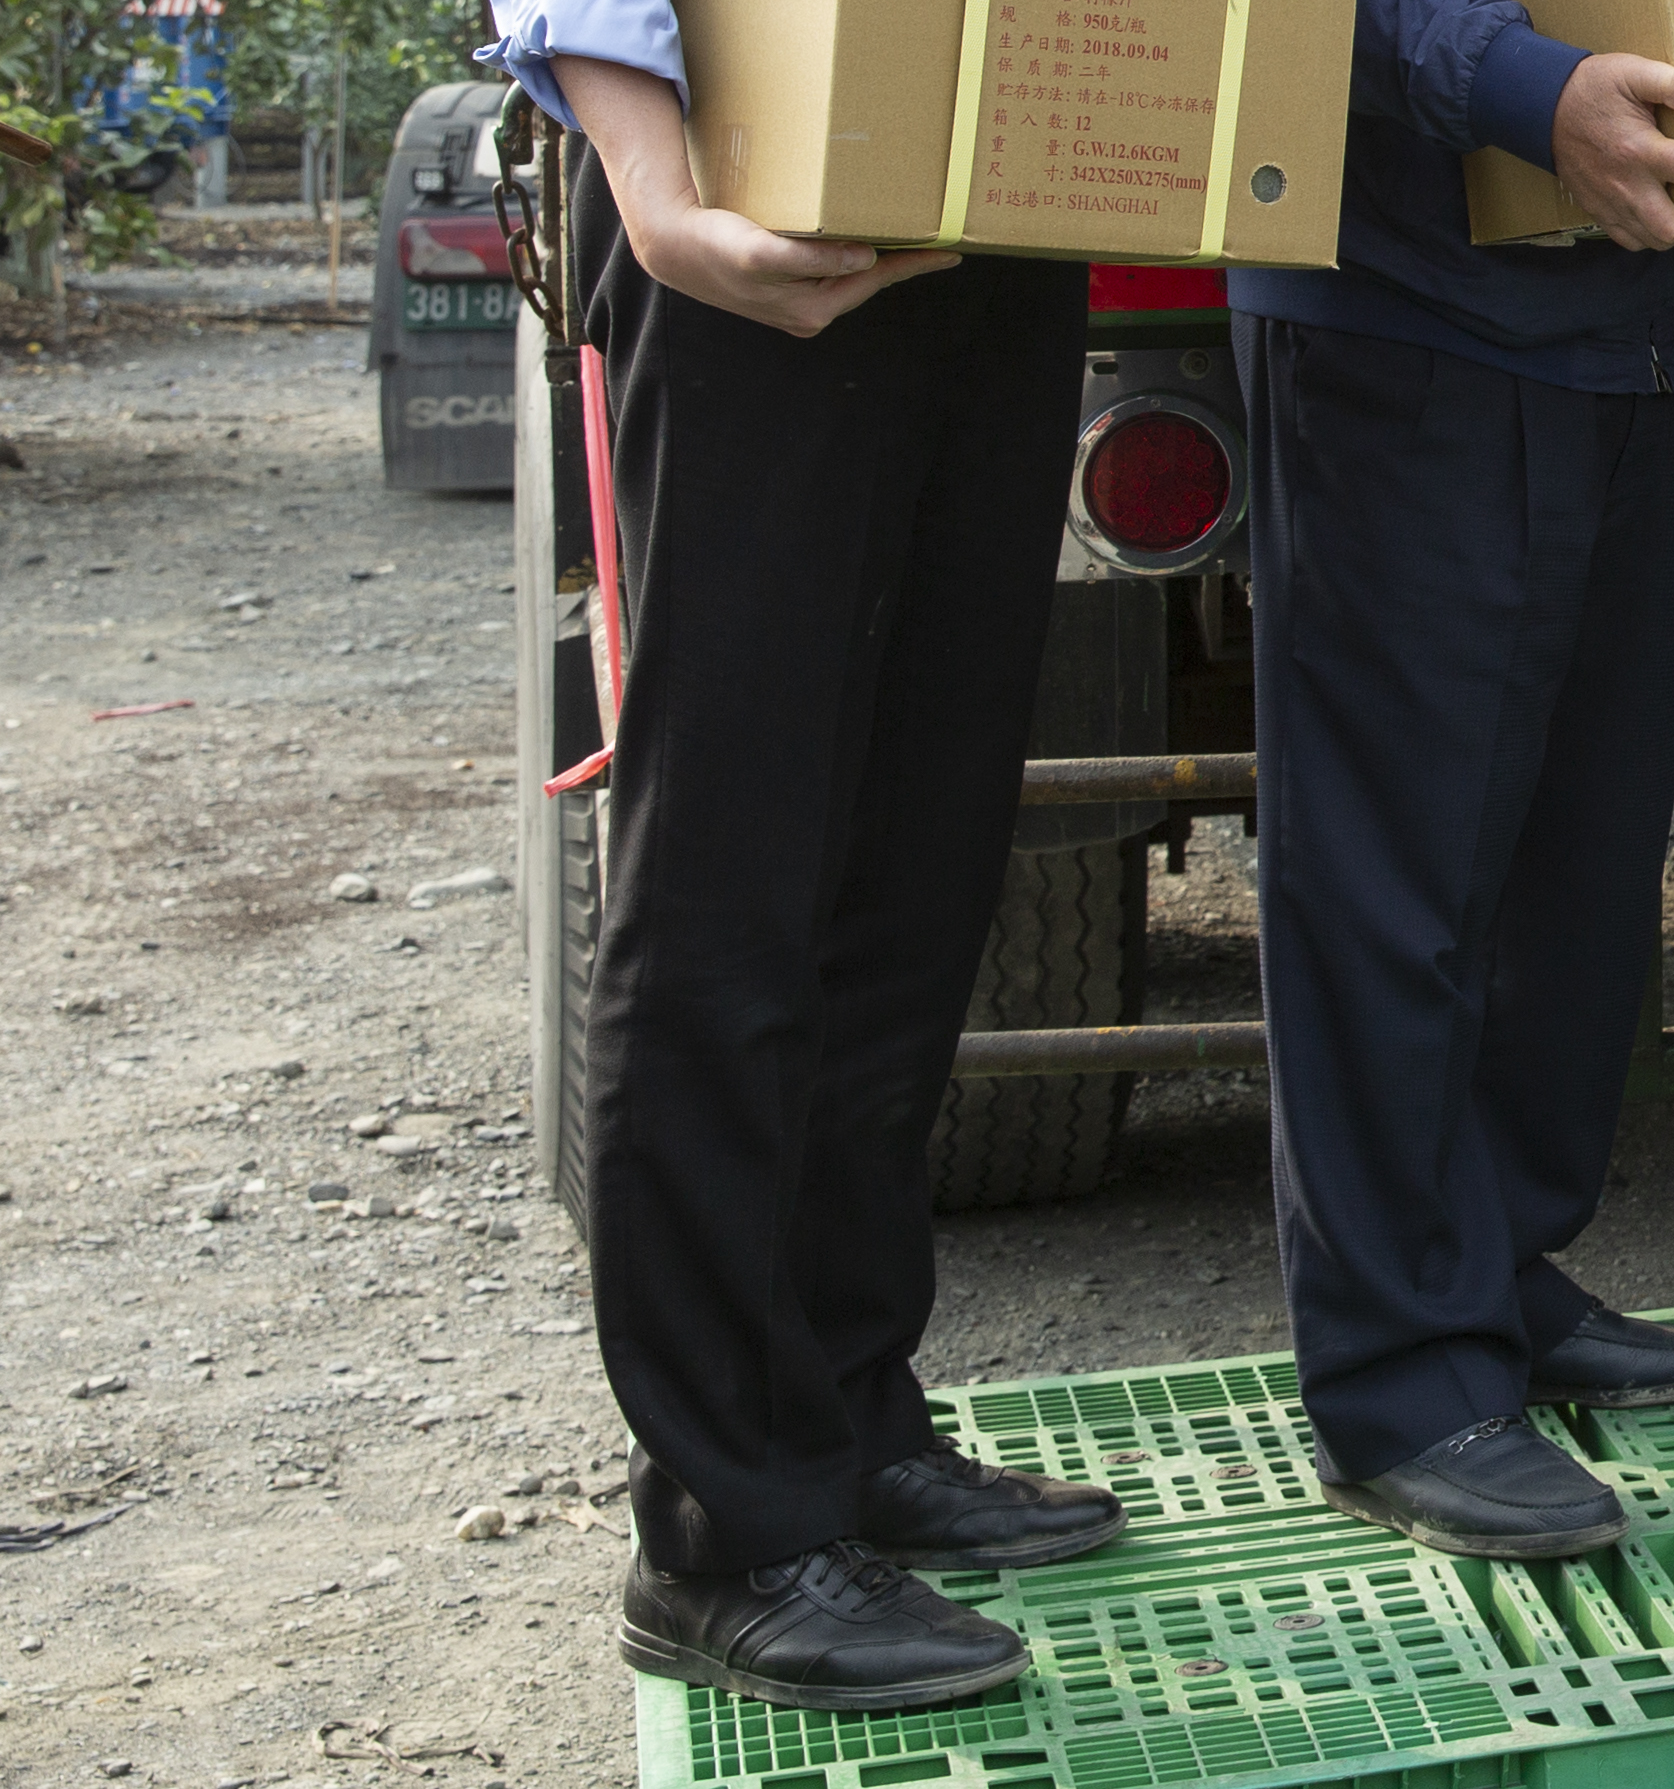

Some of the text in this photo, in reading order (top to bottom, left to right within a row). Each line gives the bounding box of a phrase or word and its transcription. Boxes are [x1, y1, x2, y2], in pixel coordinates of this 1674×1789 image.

[1082, 38, 1170, 62] 2018.09.04
[1078, 64, 1112, 80] 二年
[1075, 115, 1093, 132] 12
[1071, 140, 1181, 164] G.W.12.6KGM
[1067, 193, 1160, 217] SHANGHAI
[405, 394, 514, 429] SCA
